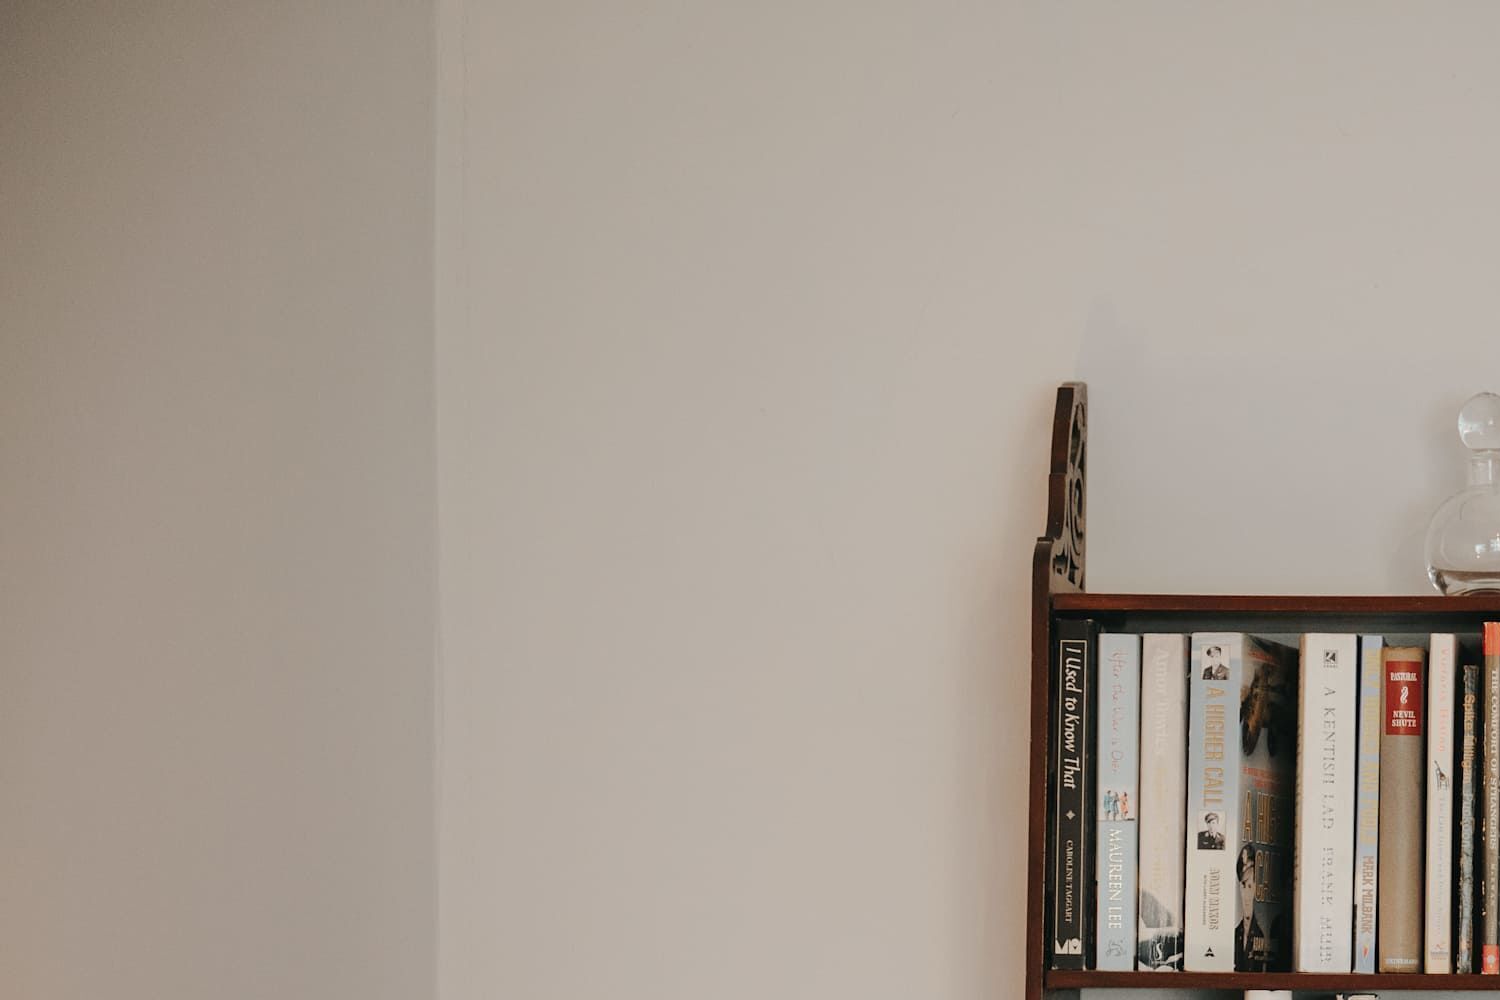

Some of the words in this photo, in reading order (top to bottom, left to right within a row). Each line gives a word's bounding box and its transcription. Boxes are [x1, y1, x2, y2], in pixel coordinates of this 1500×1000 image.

[1064, 657, 1081, 691] Used
[1108, 650, 1124, 678] After
[1110, 683, 1122, 704] the
[1206, 687, 1225, 699] A
[1323, 687, 1336, 696] A
[1490, 669, 1498, 694] THE
[1064, 697, 1078, 711] to
[1111, 707, 1124, 732] War
[1392, 710, 1416, 719] NEVIL
[1462, 694, 1476, 732] Spike
[1063, 714, 1079, 752] Know
[1203, 704, 1225, 760] HIGHER
[1489, 696, 1499, 755] COMFORT
[1322, 707, 1336, 784] KENTISH
[1063, 757, 1080, 789] That
[1110, 750, 1122, 774] Over
[1489, 758, 1498, 774] OF
[1203, 767, 1224, 808] CALL
[1321, 795, 1335, 830] LAD
[1489, 777, 1498, 850] STRANGERS
[1066, 840, 1074, 883] CAROLINE
[1108, 829, 1122, 901] MAUREEN
[1362, 855, 1374, 885] MARK
[1208, 869, 1221, 895] ADAM
[1065, 884, 1073, 923] TAGGART
[1108, 907, 1122, 929] LEE
[1361, 888, 1374, 934] MILBANK
